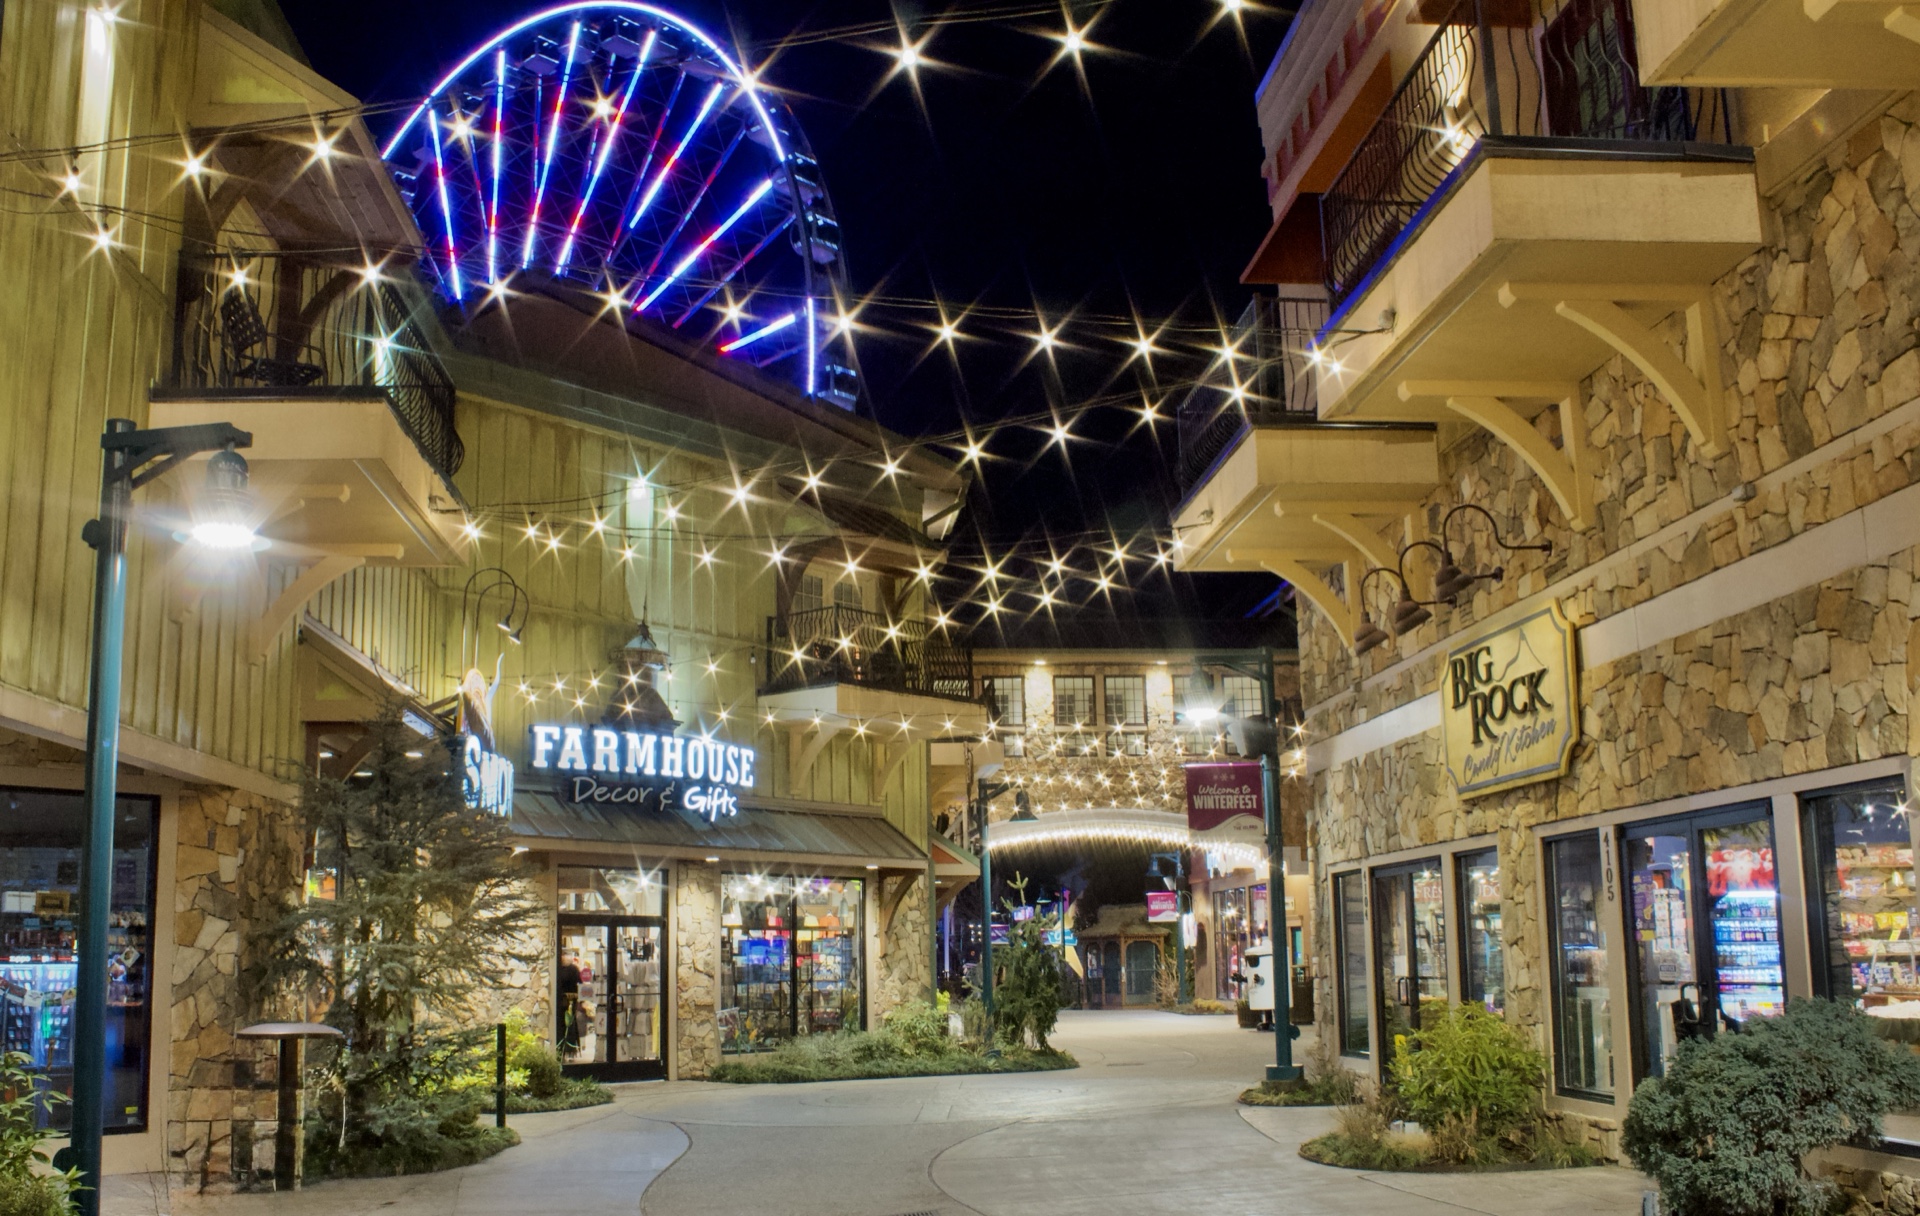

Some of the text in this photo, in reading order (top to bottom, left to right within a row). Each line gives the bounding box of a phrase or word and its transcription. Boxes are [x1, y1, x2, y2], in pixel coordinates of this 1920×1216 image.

[1450, 645, 1494, 710] BIG
[1468, 668, 1552, 744] ROCK
[533, 725, 755, 787] FARMHOUSE
[1501, 714, 1557, 764] Kitchen
[572, 775, 738, 823] Decor & Gifts
[1193, 794, 1258, 810] WINTERFEST
[1198, 783, 1251, 795] Welcome to
[1603, 831, 1615, 901] 4105
